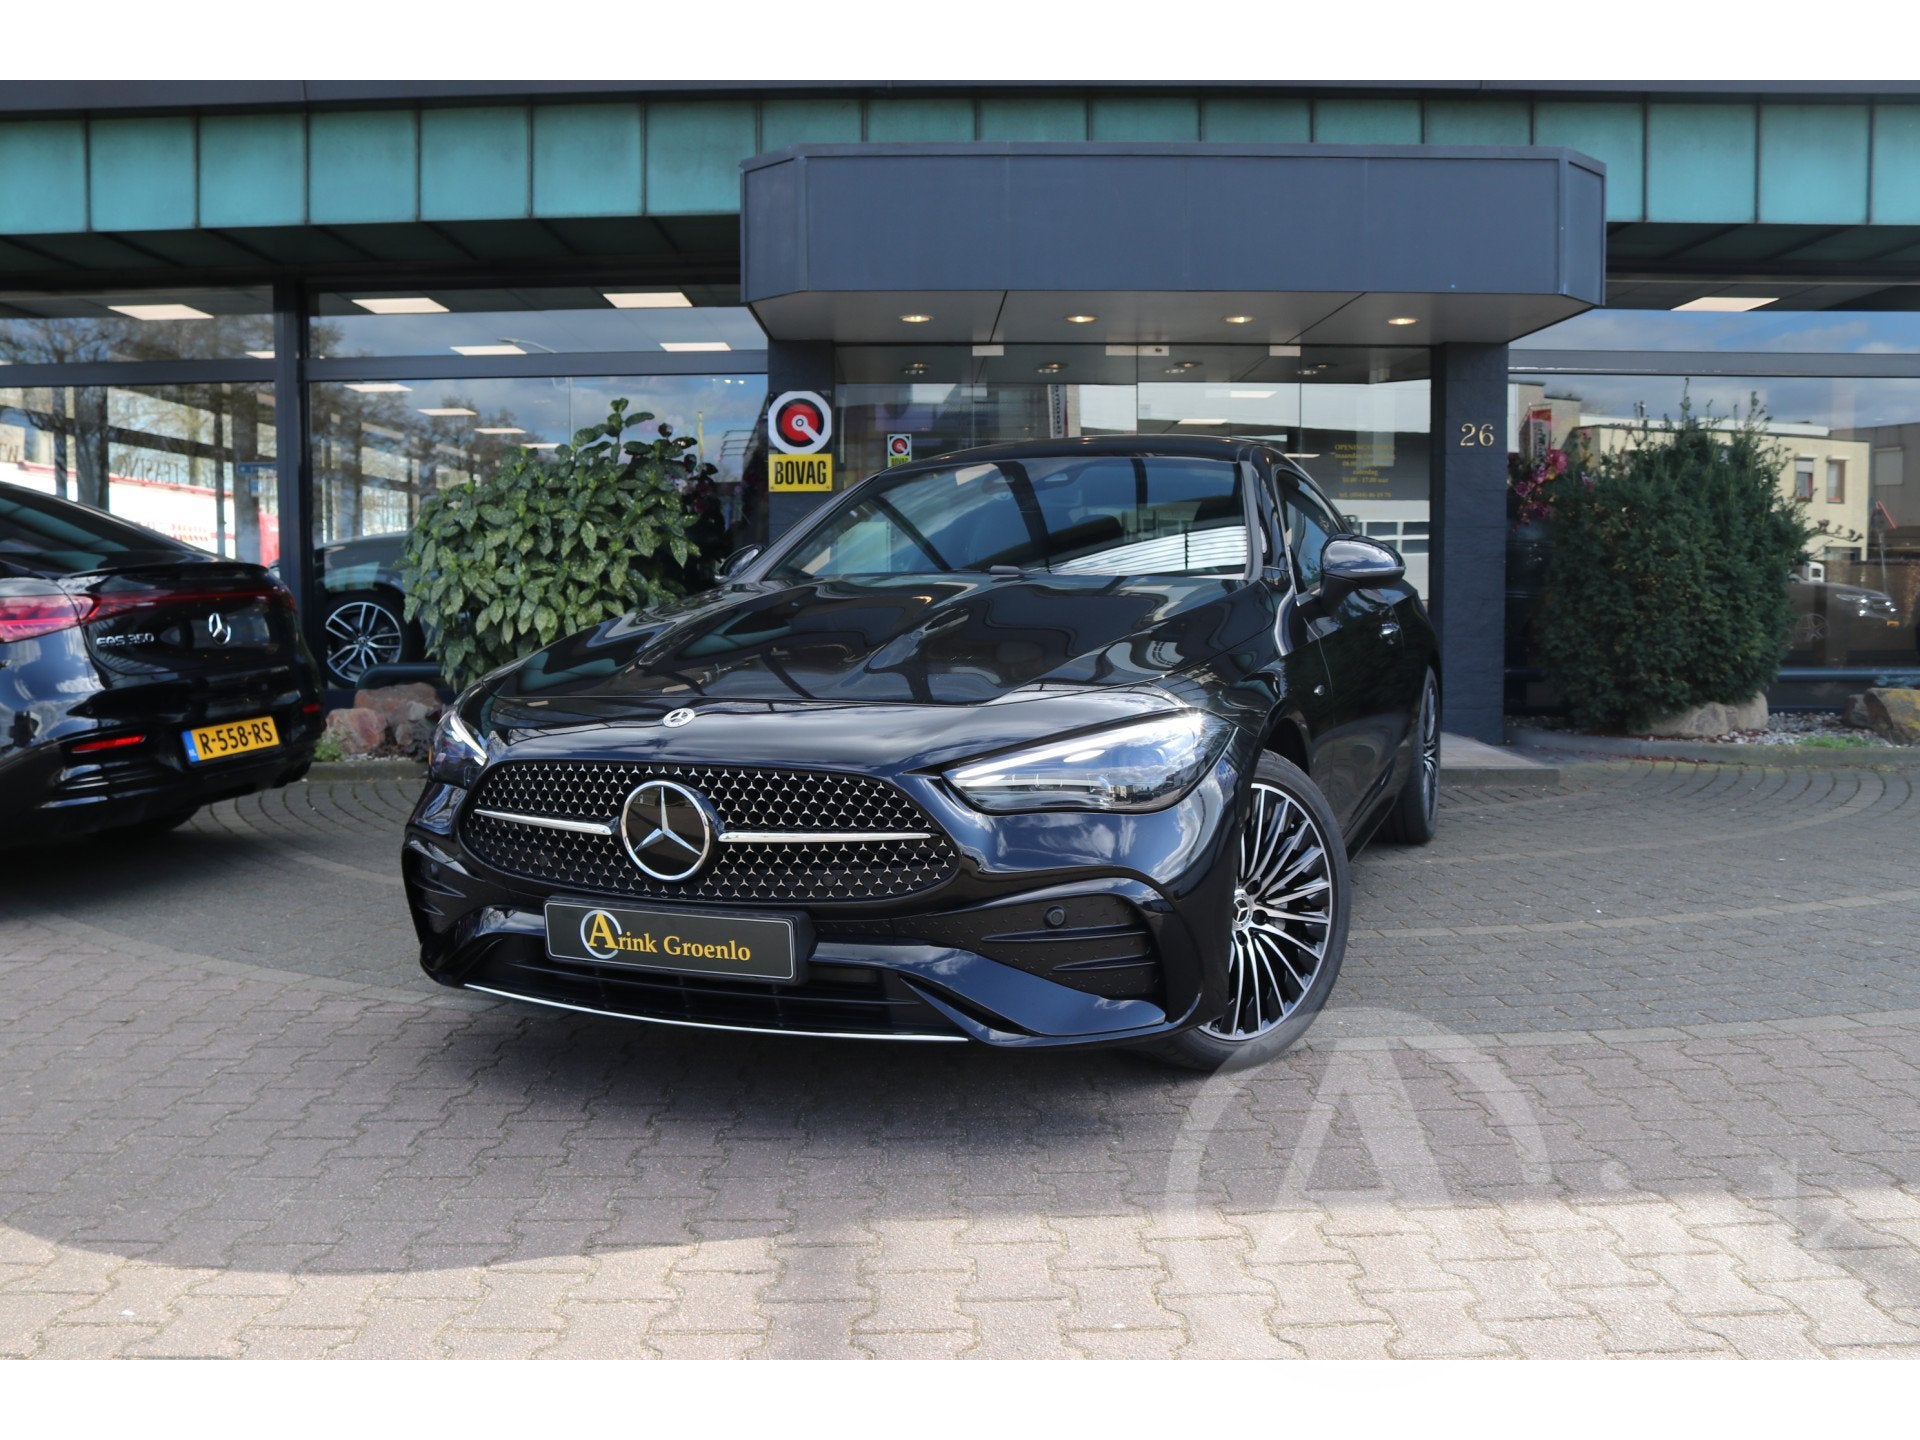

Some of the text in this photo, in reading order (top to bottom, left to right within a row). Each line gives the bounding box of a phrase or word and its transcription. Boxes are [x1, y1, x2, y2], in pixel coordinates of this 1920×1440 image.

[1460, 423, 1495, 447] 26
[774, 460, 827, 485] BOVAG
[198, 721, 273, 755] R-558-RS
[663, 935, 751, 962] Groenlo
